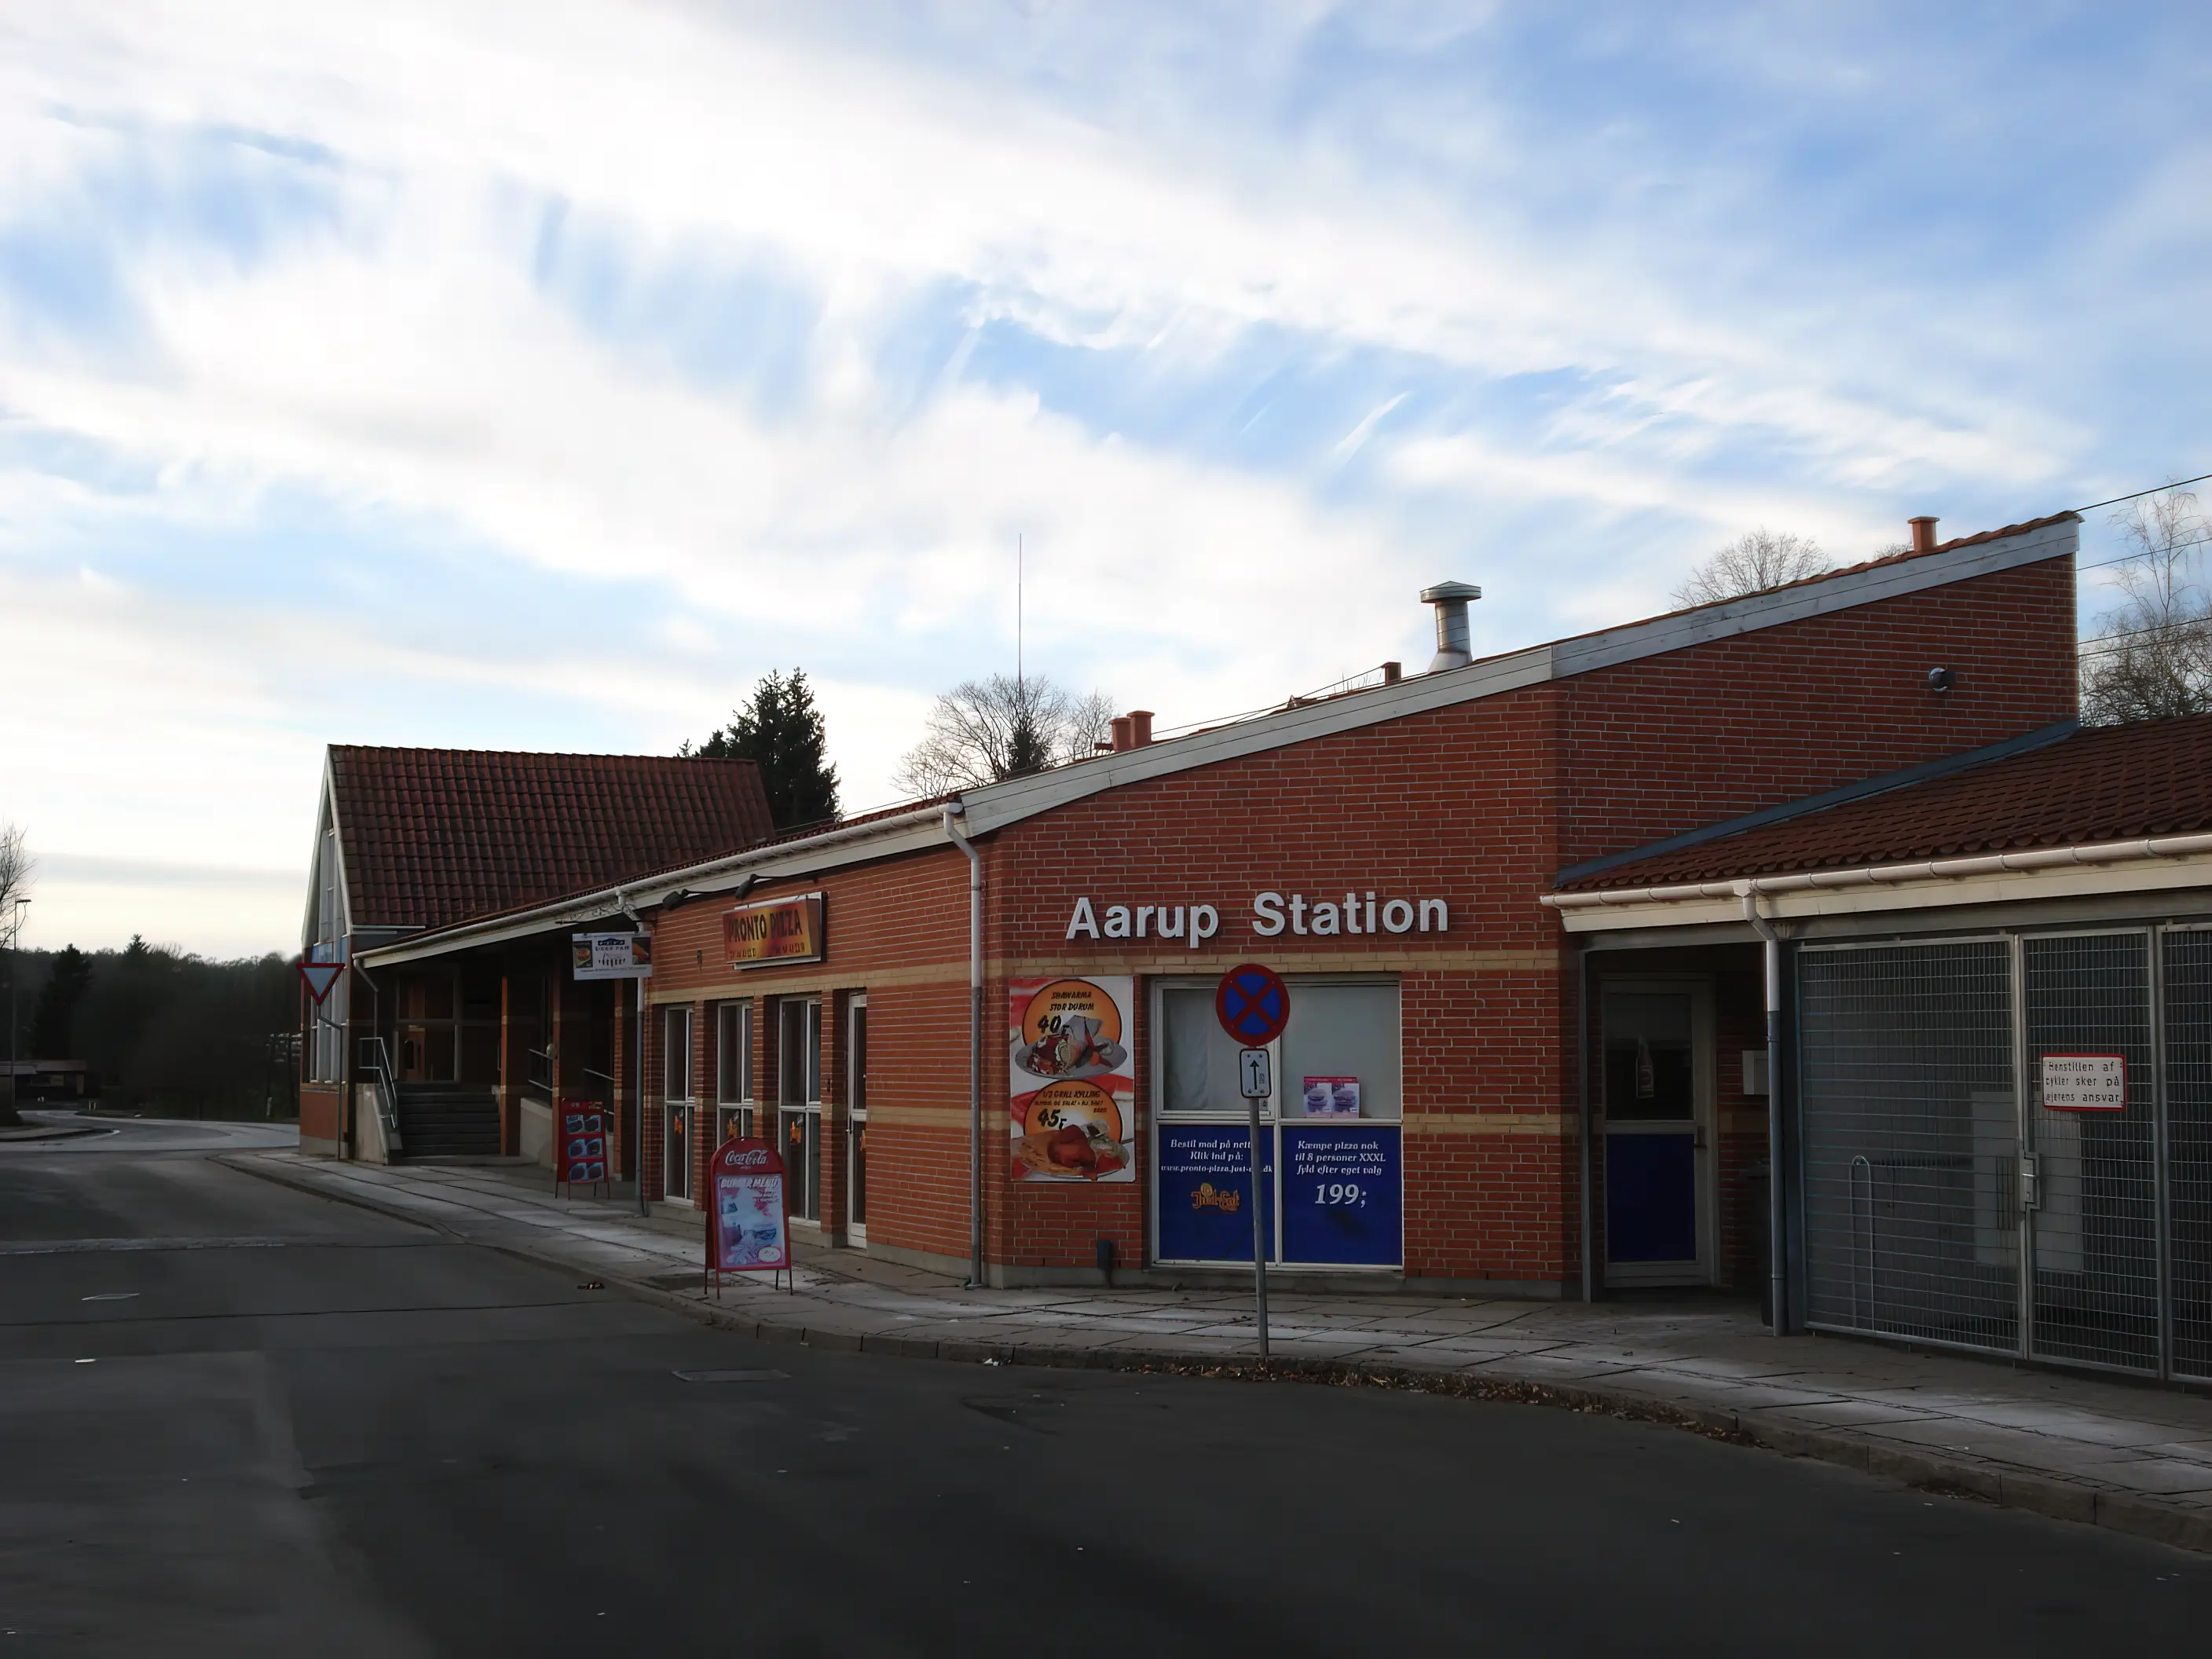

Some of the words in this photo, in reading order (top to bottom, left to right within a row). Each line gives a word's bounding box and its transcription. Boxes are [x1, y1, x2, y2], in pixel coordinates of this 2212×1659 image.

[1066, 897, 1219, 949] Aarup
[1252, 892, 1448, 937] Station
[728, 914, 767, 942] PRONTO
[1049, 1002, 1067, 1011] STOR
[2049, 1061, 2094, 1071] Henstillen
[2103, 1061, 2115, 1071] af
[2045, 1076, 2069, 1086] cykler
[2076, 1076, 2097, 1086] sker
[2106, 1076, 2119, 1086] på
[2045, 1092, 2075, 1103] ejerens
[1170, 1139, 1196, 1148] Bestil
[1219, 1139, 1231, 1149] på
[1298, 1141, 1332, 1151] Kæmpe
[1335, 1141, 1358, 1151] pizza
[1361, 1141, 1379, 1150] nok
[1190, 1151, 1209, 1160] Klik
[1211, 1151, 1225, 1160] ind
[1295, 1152, 1306, 1161] til
[1307, 1152, 1314, 1161] 8
[1316, 1154, 1357, 1163] personer
[1359, 1152, 1386, 1162] XXXL
[1296, 1164, 1315, 1175] fyld
[1317, 1165, 1339, 1175] efter
[1341, 1166, 1361, 1176] eget
[1363, 1165, 1382, 1176] valg
